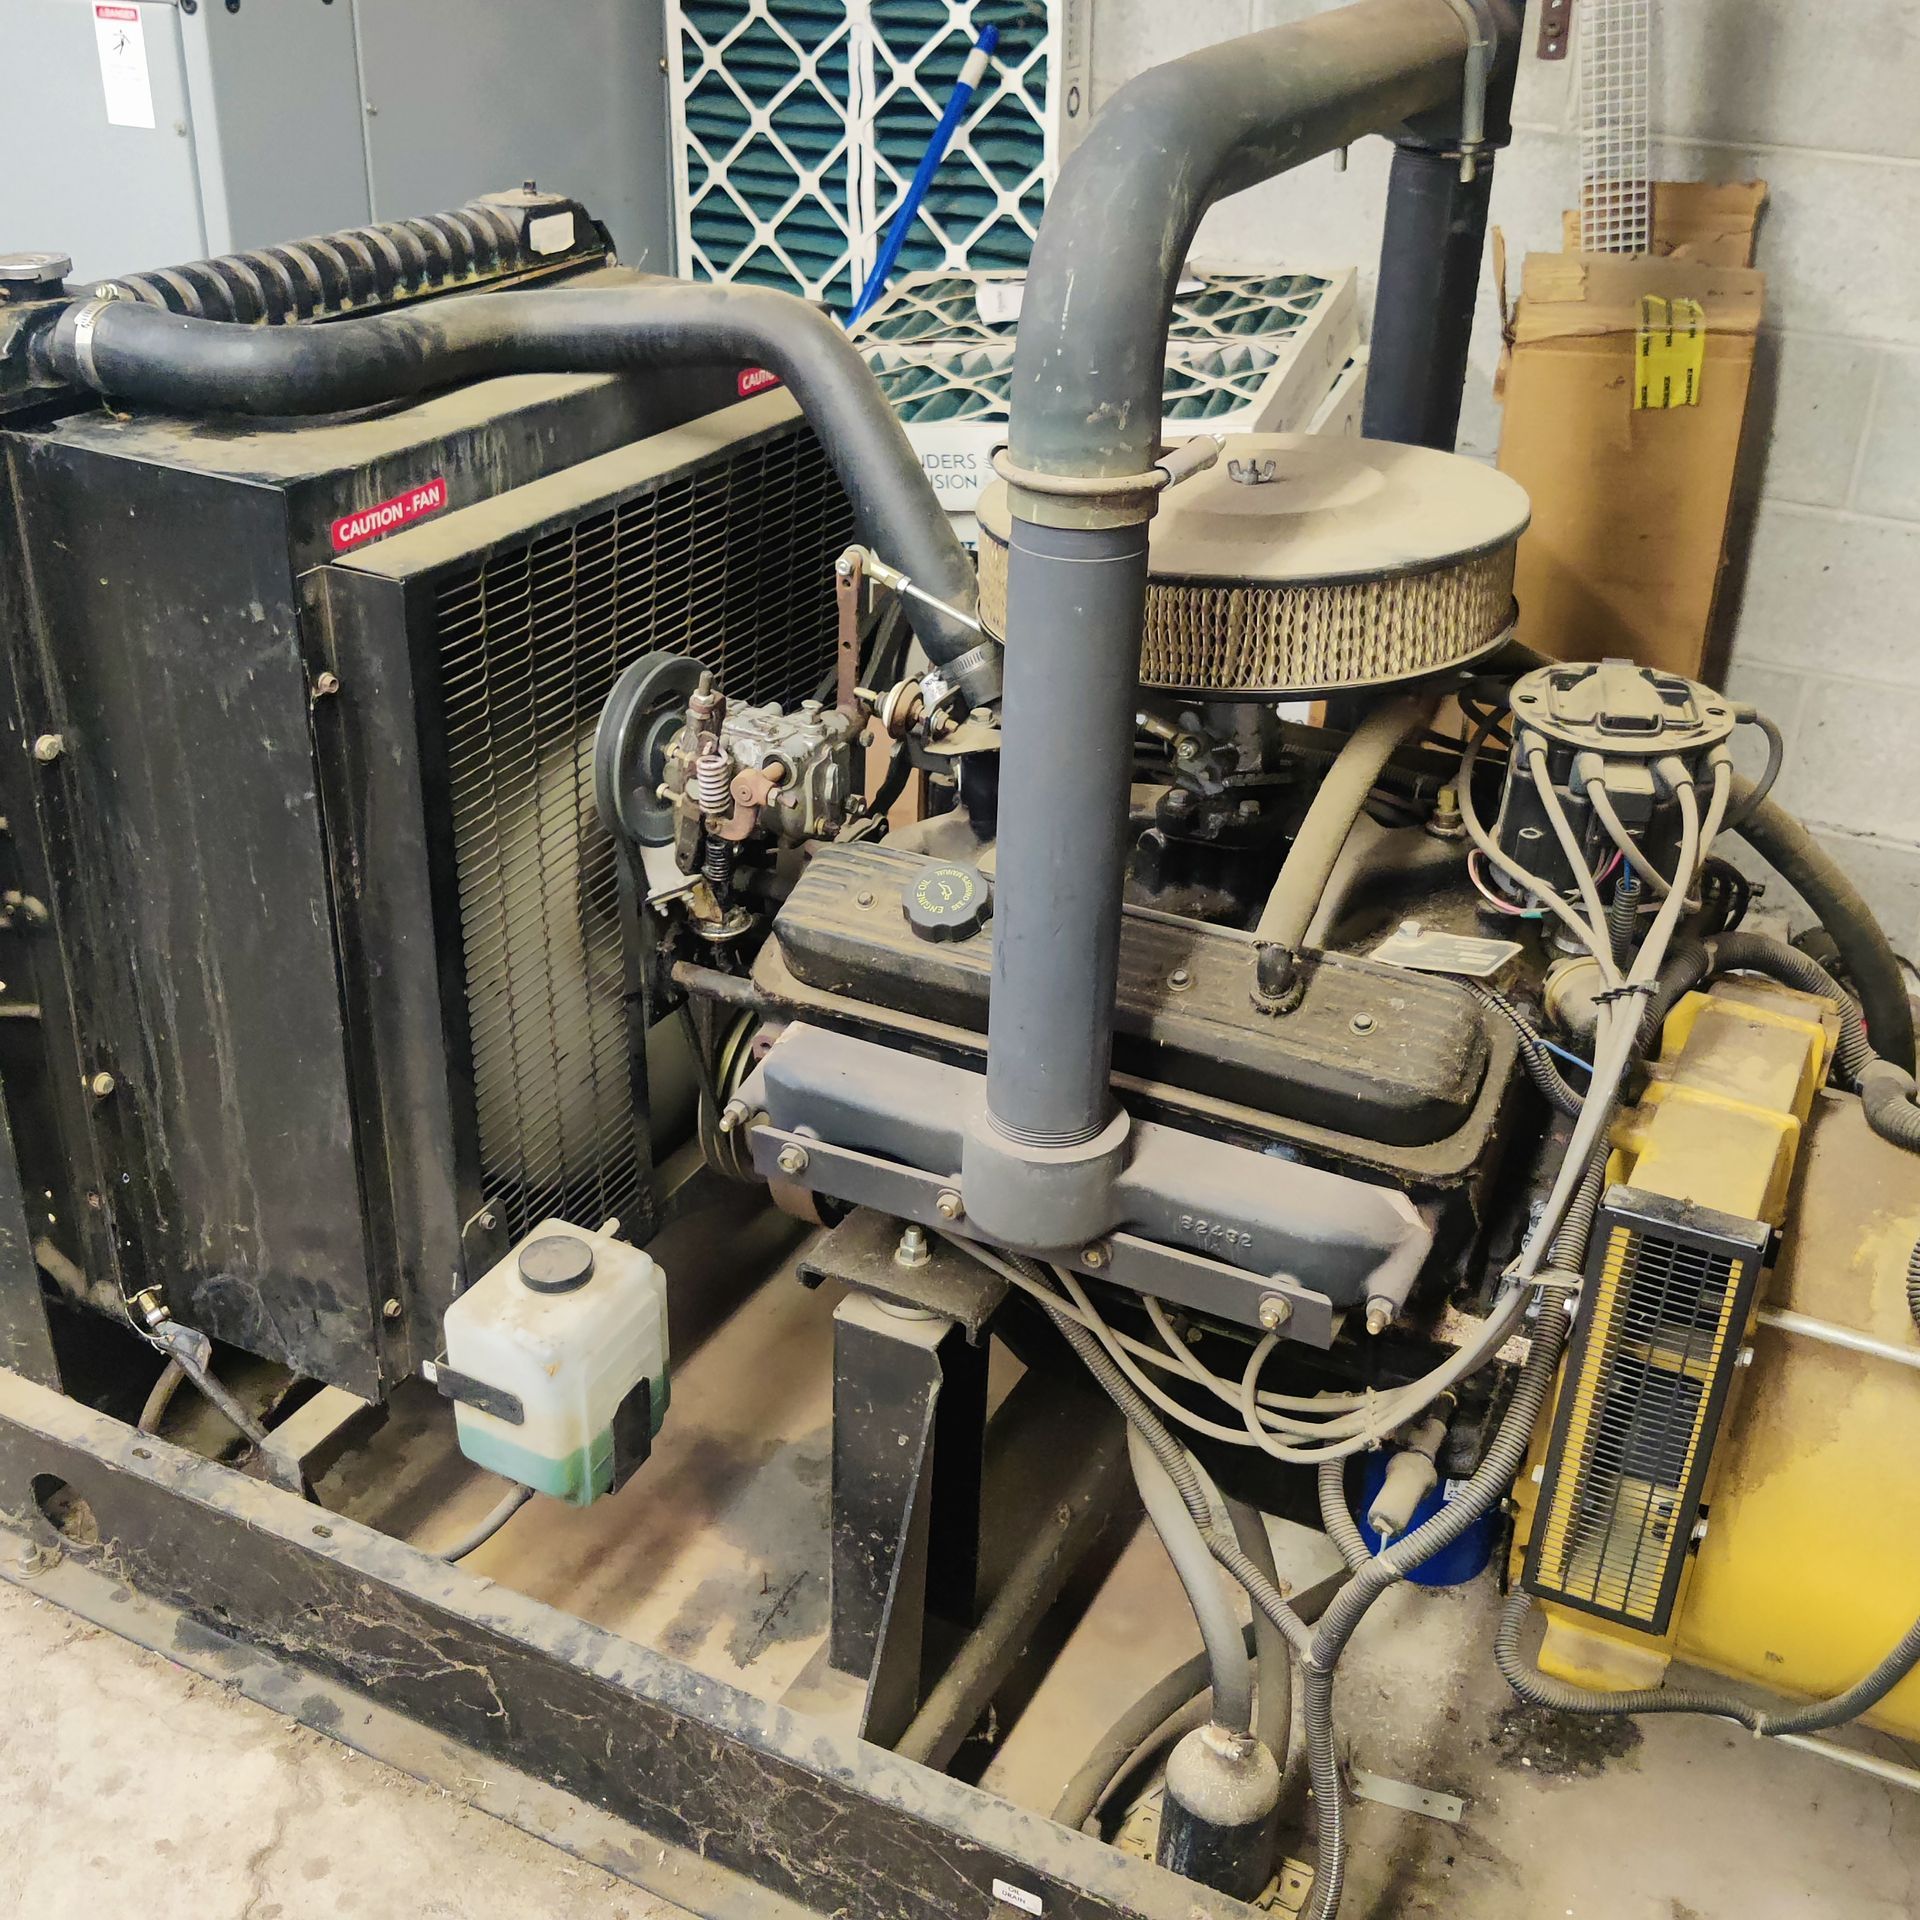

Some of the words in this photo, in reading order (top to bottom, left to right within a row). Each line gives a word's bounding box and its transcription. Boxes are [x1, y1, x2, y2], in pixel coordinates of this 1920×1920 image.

[339, 502, 403, 542] CAUTION
[413, 486, 440, 512] FAN
[918, 879, 932, 891] OIL
[917, 891, 944, 914] ENGINE
